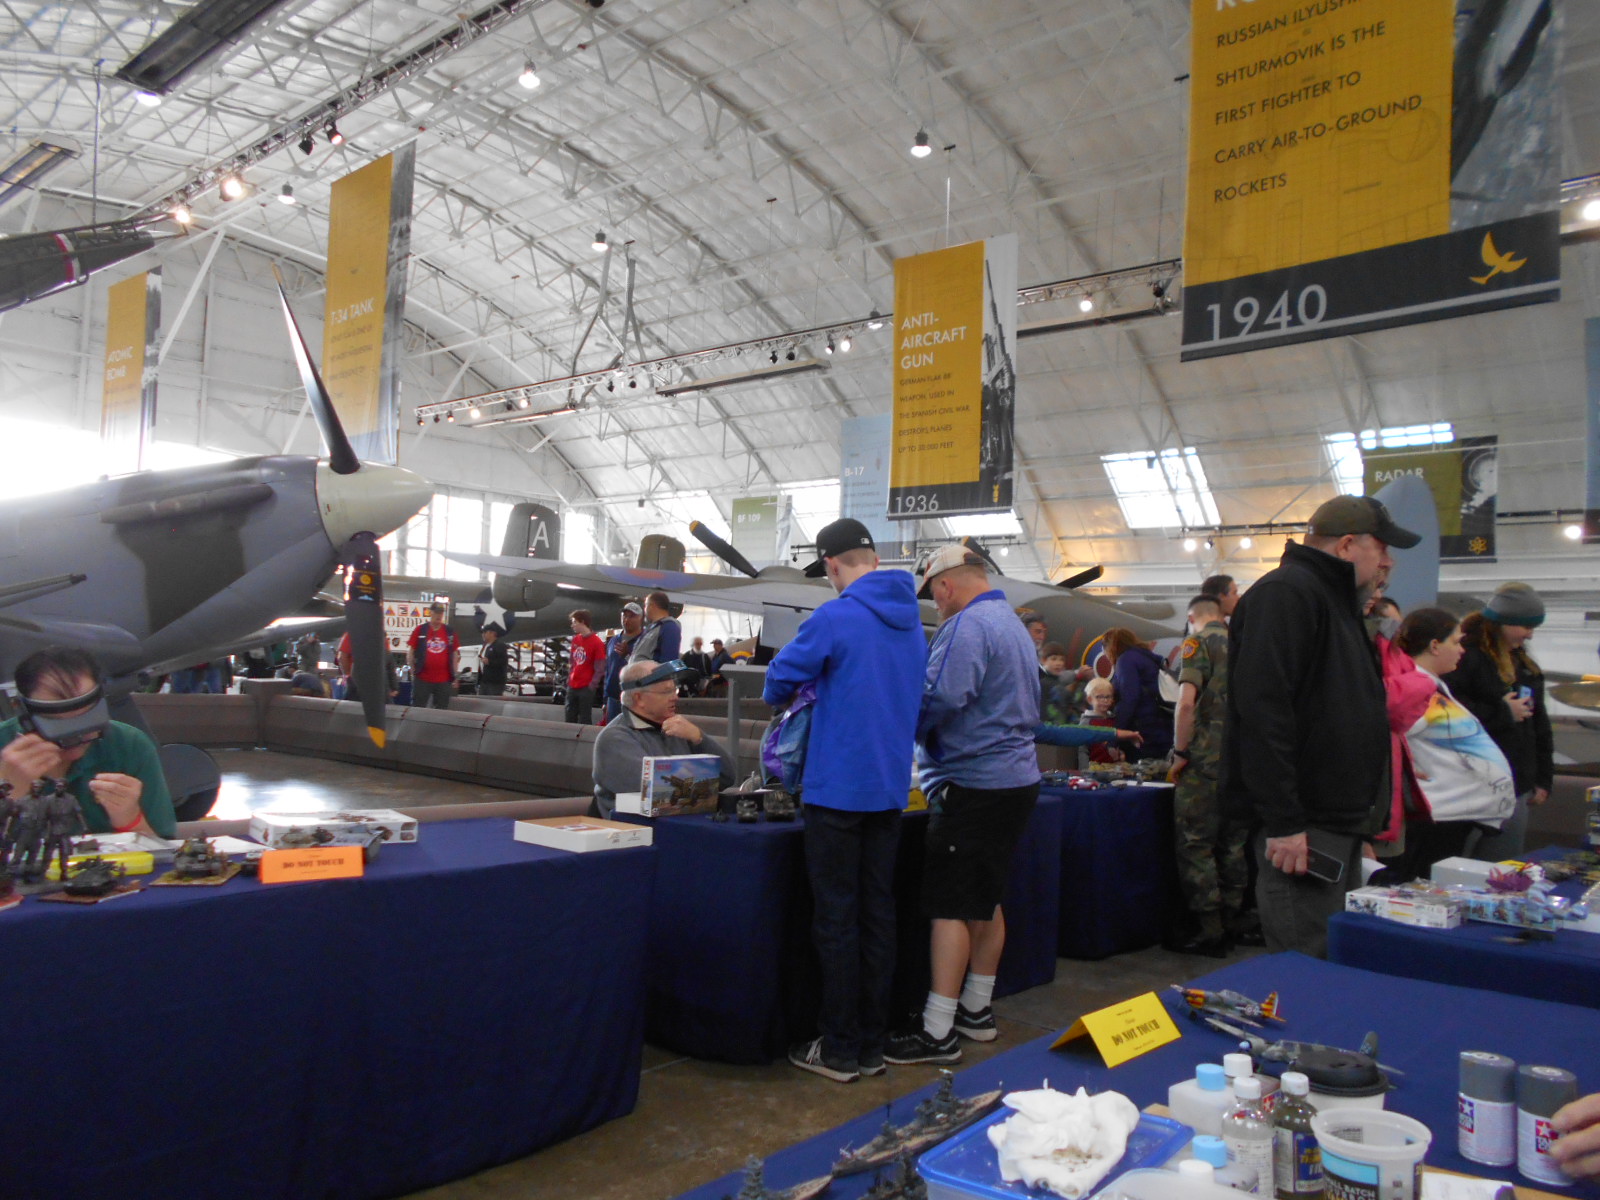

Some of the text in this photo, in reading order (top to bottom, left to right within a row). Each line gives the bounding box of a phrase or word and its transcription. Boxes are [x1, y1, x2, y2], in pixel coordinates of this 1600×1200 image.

[1216, 15, 1288, 48] RUSSIAN
[1216, 20, 1387, 88] SHTURMOVIK IS THE
[1215, 70, 1361, 126] FIRST FIGHTER TO
[1214, 138, 1265, 165] CARRY
[1214, 173, 1288, 204] ROCKETS
[331, 297, 375, 326] T-34 TANK
[901, 311, 940, 331] ANTI-
[1206, 284, 1328, 341] 1940
[901, 326, 967, 350] AIRCRAFT
[901, 352, 935, 369] GUN
[929, 390, 946, 399] USED
[947, 389, 955, 397] IN
[899, 412, 910, 420] THE
[911, 409, 937, 418] SPANISH
[938, 407, 954, 415] CIVIL
[899, 424, 953, 437] DESTROYS PLANES
[908, 445, 916, 453] TO
[940, 441, 954, 449] FEET
[844, 466, 865, 477] B-17
[1375, 467, 1424, 483] RADAR
[895, 493, 939, 514] 1936
[737, 513, 761, 524] BF 109
[532, 520, 550, 548] A
[283, 861, 294, 869] DO
[317, 858, 344, 866] TOUCH
[1111, 1033, 1124, 1047] DO
[1121, 1028, 1138, 1042] NOT
[1136, 1019, 1160, 1036] TOUCH
